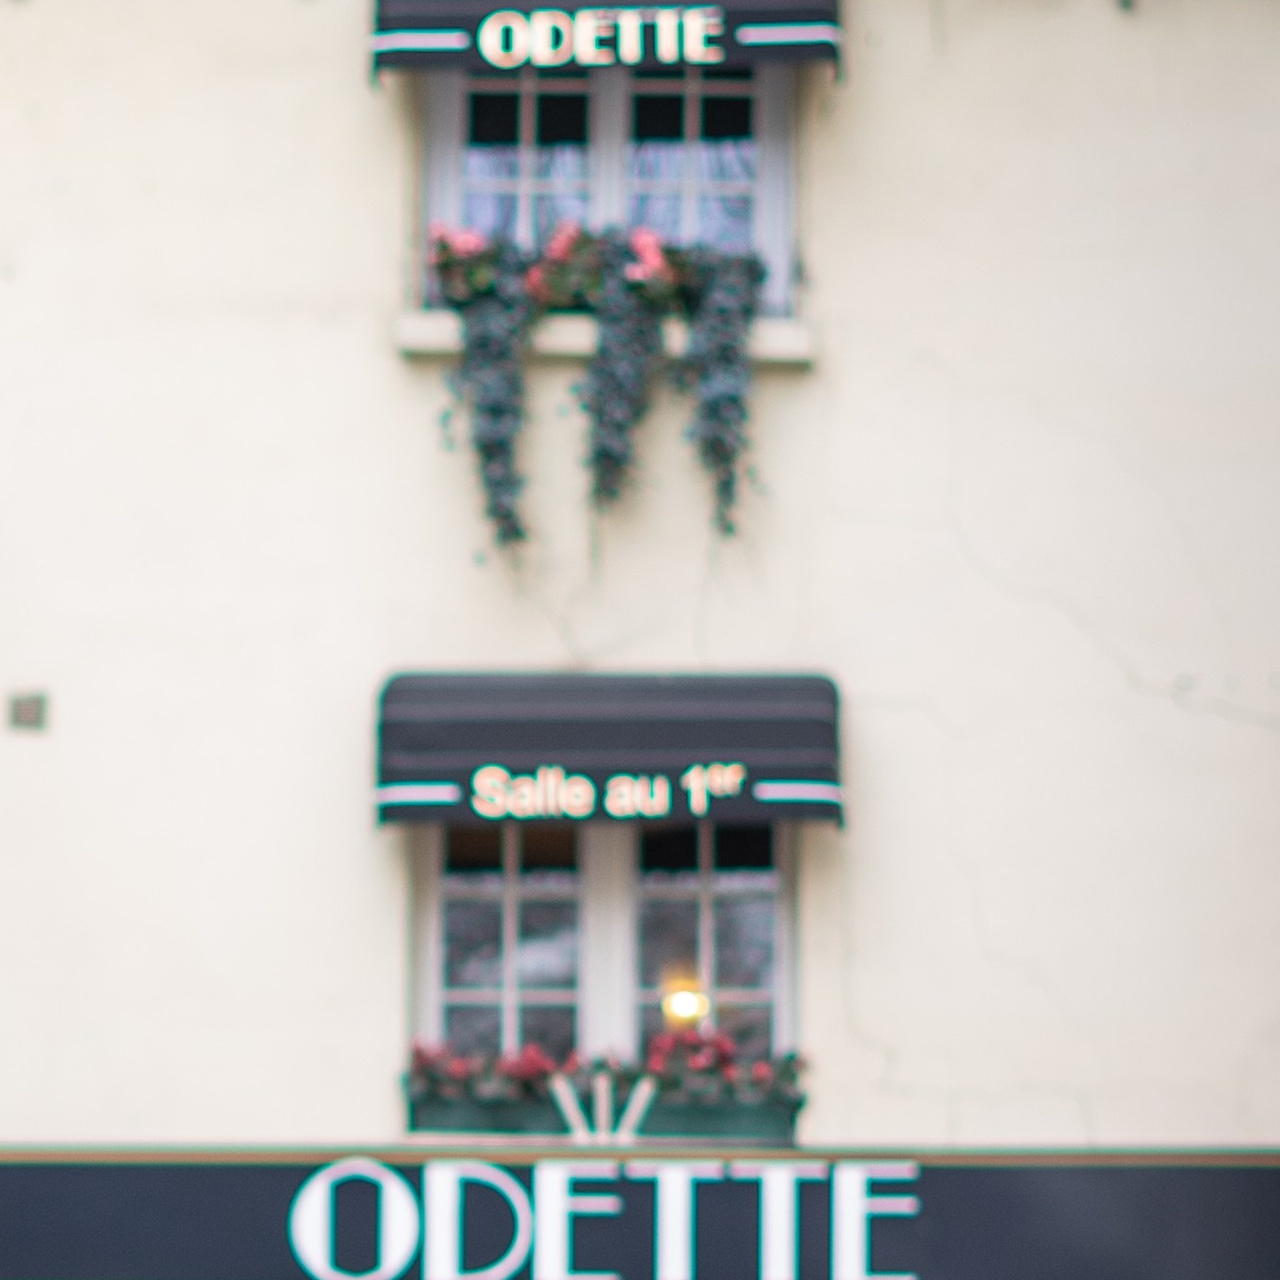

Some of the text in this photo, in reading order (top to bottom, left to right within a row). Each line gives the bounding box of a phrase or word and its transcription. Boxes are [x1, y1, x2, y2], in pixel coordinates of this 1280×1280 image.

[478, 7, 724, 68] ODETTE
[471, 765, 596, 818] Salle
[604, 775, 670, 817] au
